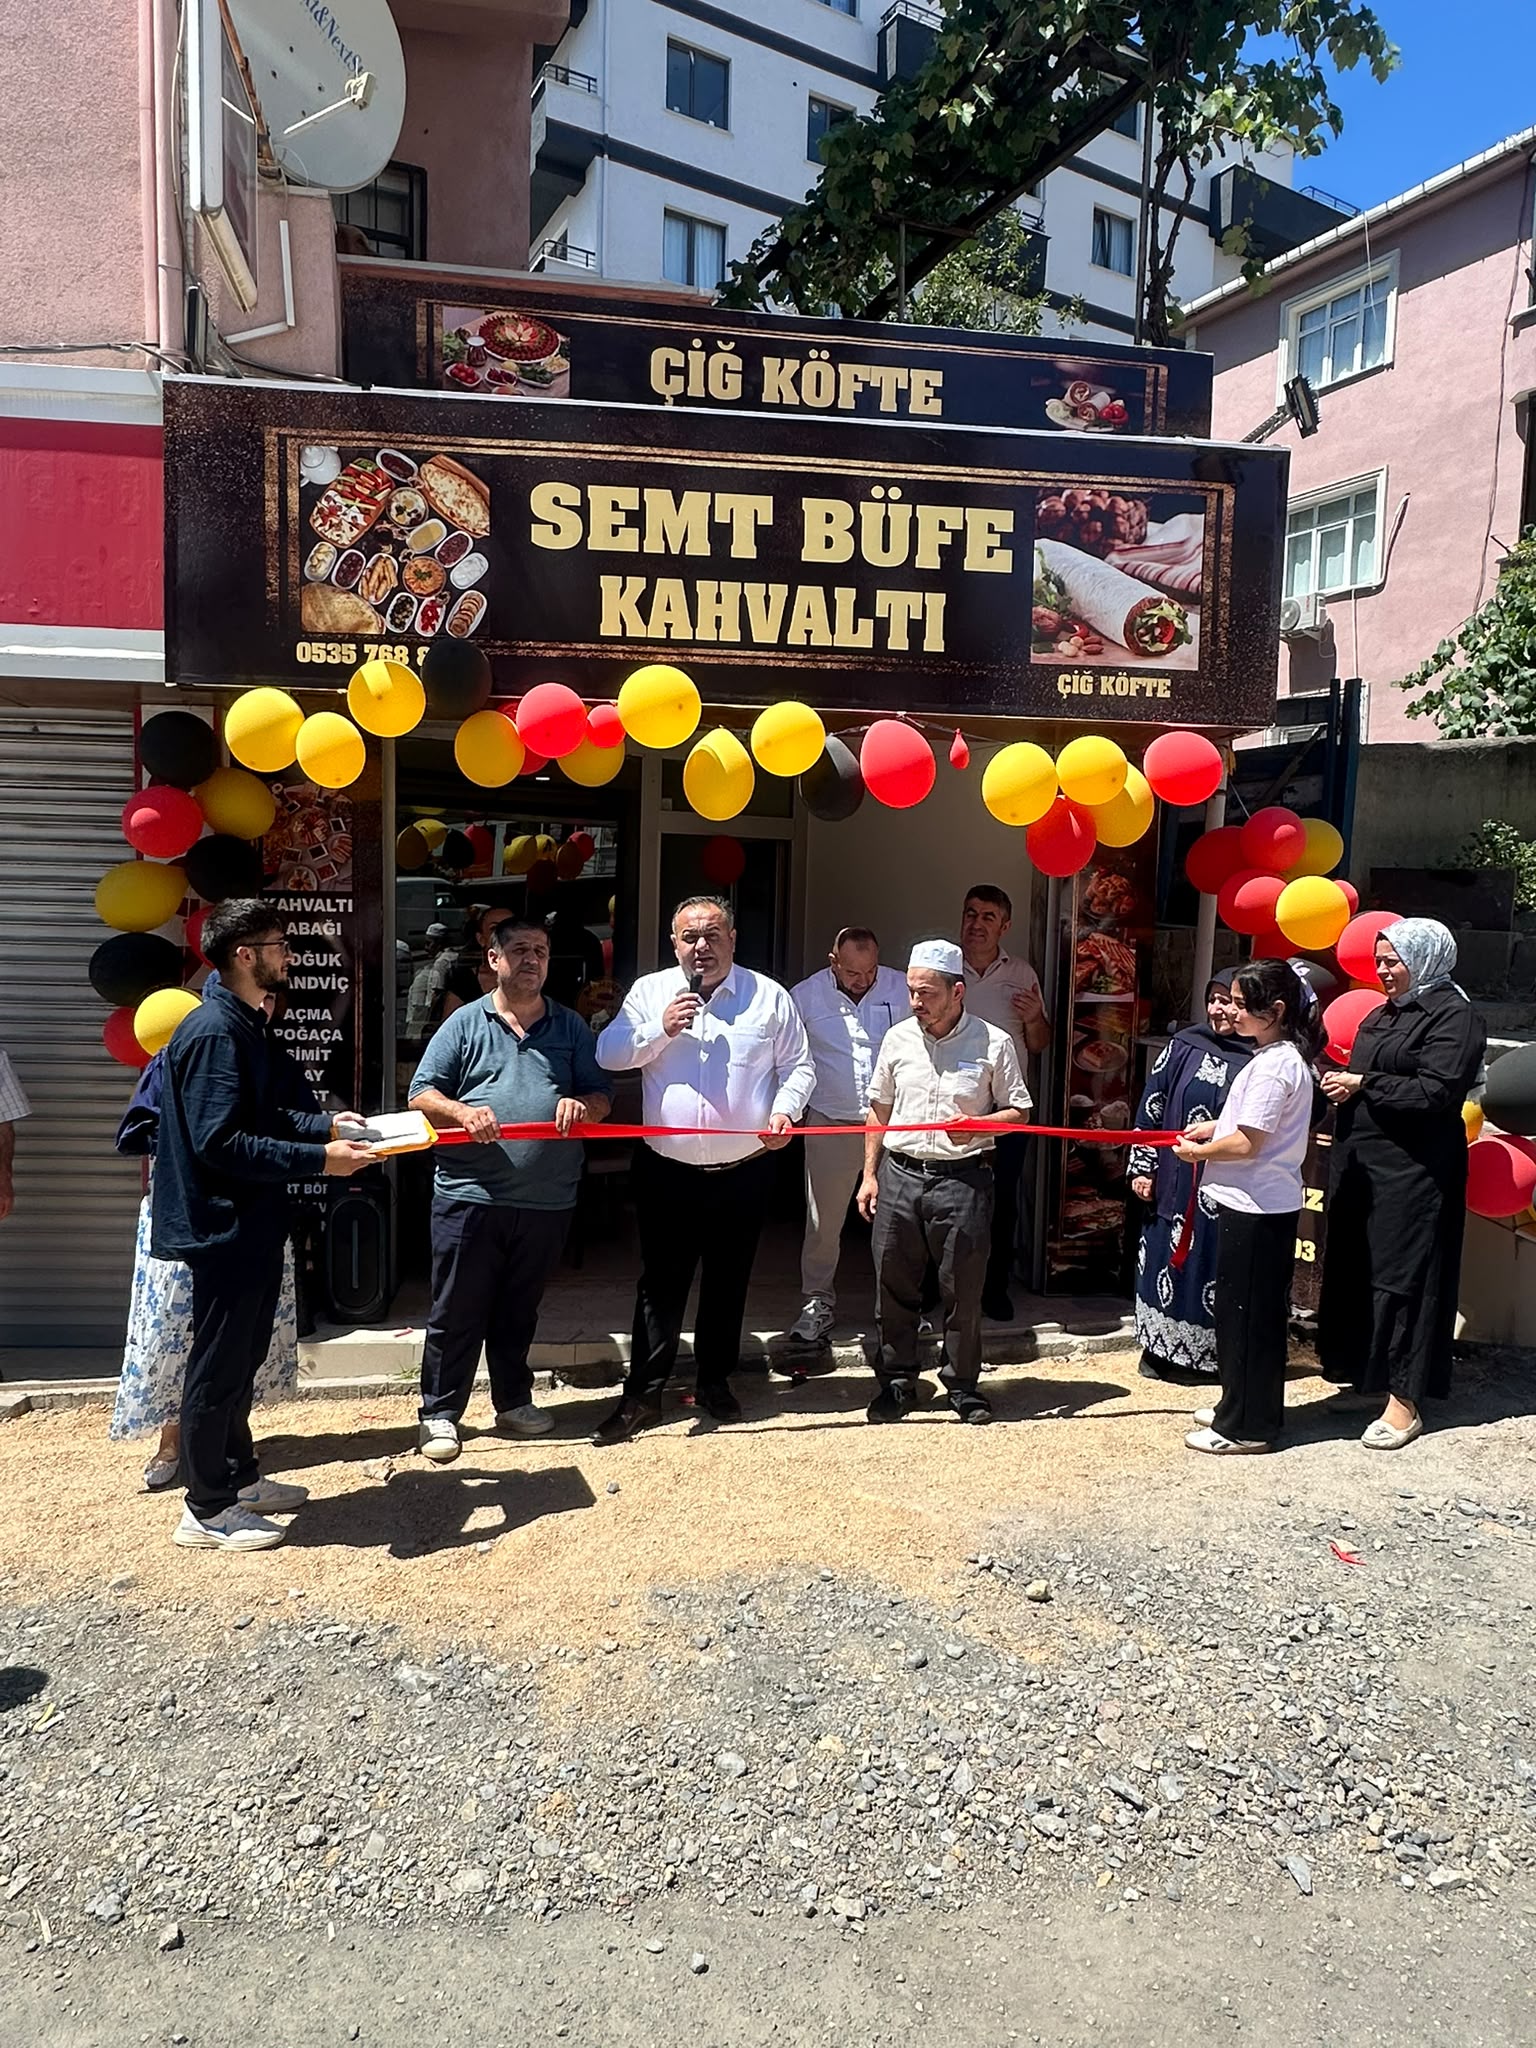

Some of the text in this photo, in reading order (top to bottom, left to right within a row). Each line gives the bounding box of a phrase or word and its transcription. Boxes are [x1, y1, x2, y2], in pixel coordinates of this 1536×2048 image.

[650, 338, 943, 416] ÇİĞ KÖFTE
[530, 482, 1015, 573] SEMT BÜFE
[600, 575, 947, 653] KAHVALTI
[296, 641, 357, 665] 0535
[363, 644, 409, 667] 768
[1057, 669, 1172, 700] ÇİĞ KÖFTE
[286, 918, 342, 936] ABAĞI
[290, 950, 342, 967] OĞUK
[283, 1008, 333, 1024] AÇMA
